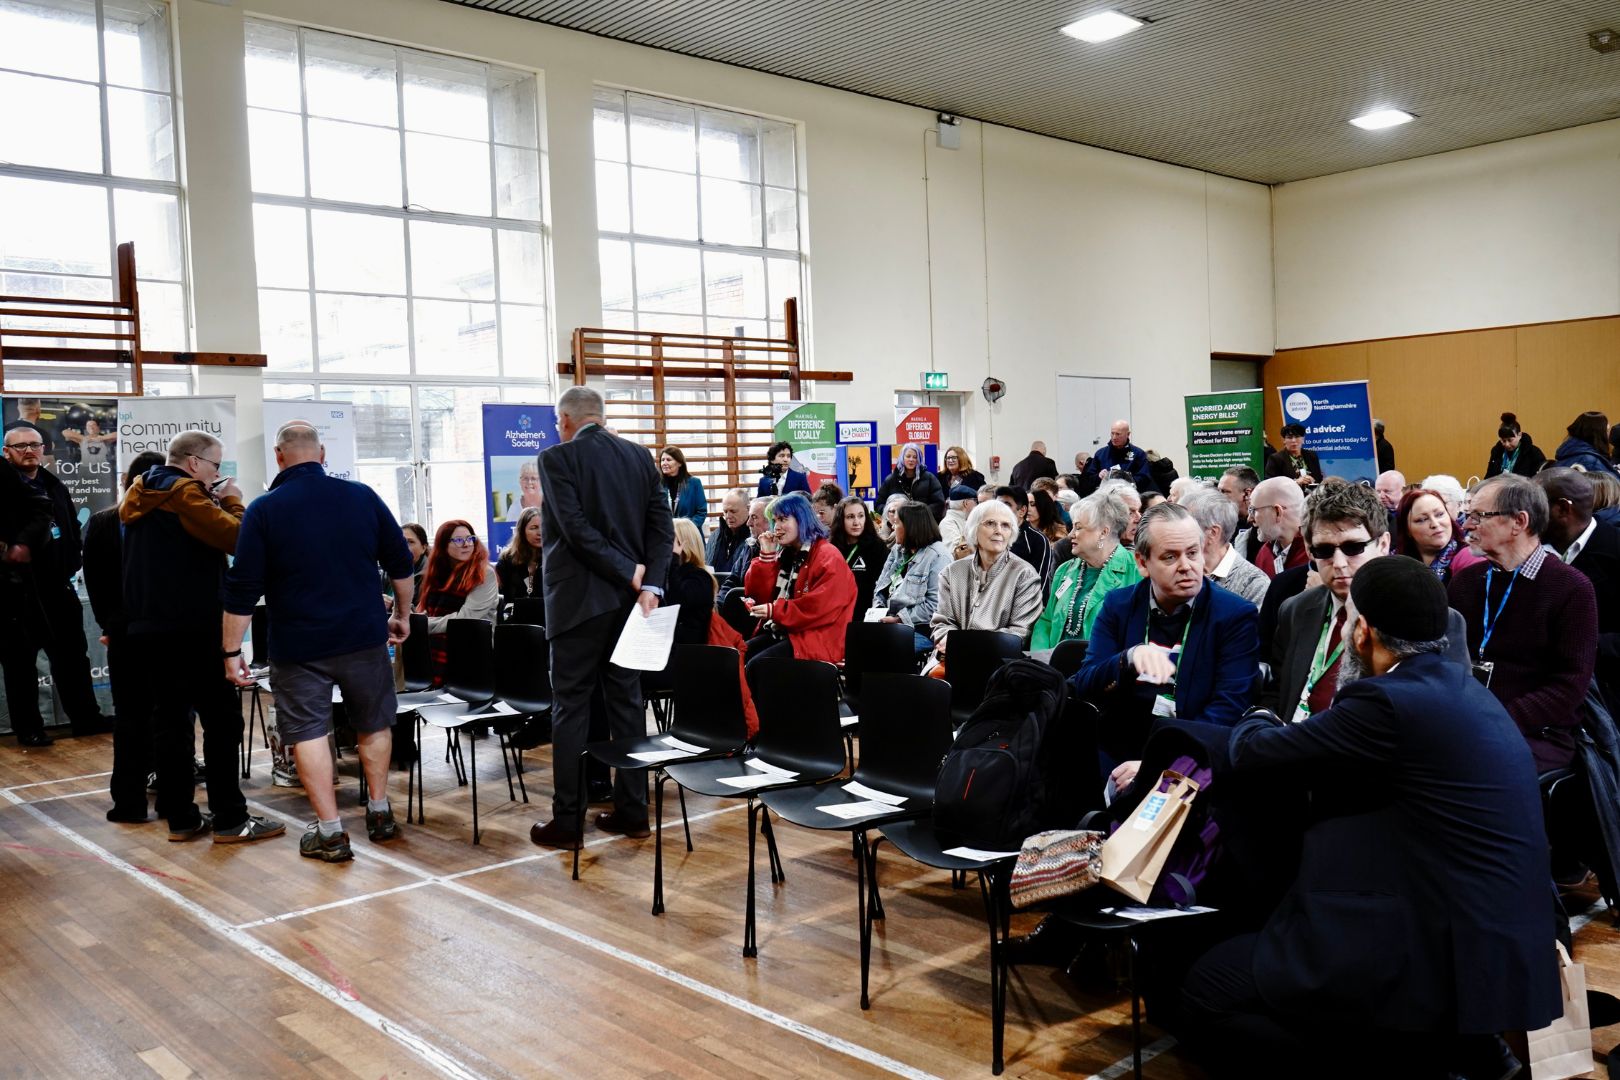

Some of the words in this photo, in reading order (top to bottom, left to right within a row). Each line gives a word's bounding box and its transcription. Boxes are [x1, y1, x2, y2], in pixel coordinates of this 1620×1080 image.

[120, 420, 222, 438] community
[788, 420, 825, 429] DIFFERENCE
[906, 422, 932, 430] DIFFERENCE
[1313, 425, 1346, 433] advice?
[505, 430, 546, 439] Alzheimer's
[794, 430, 820, 439] LOCALLY
[120, 438, 172, 454] healt
[512, 439, 540, 449] Society
[55, 460, 83, 474] for
[89, 462, 111, 474] us
